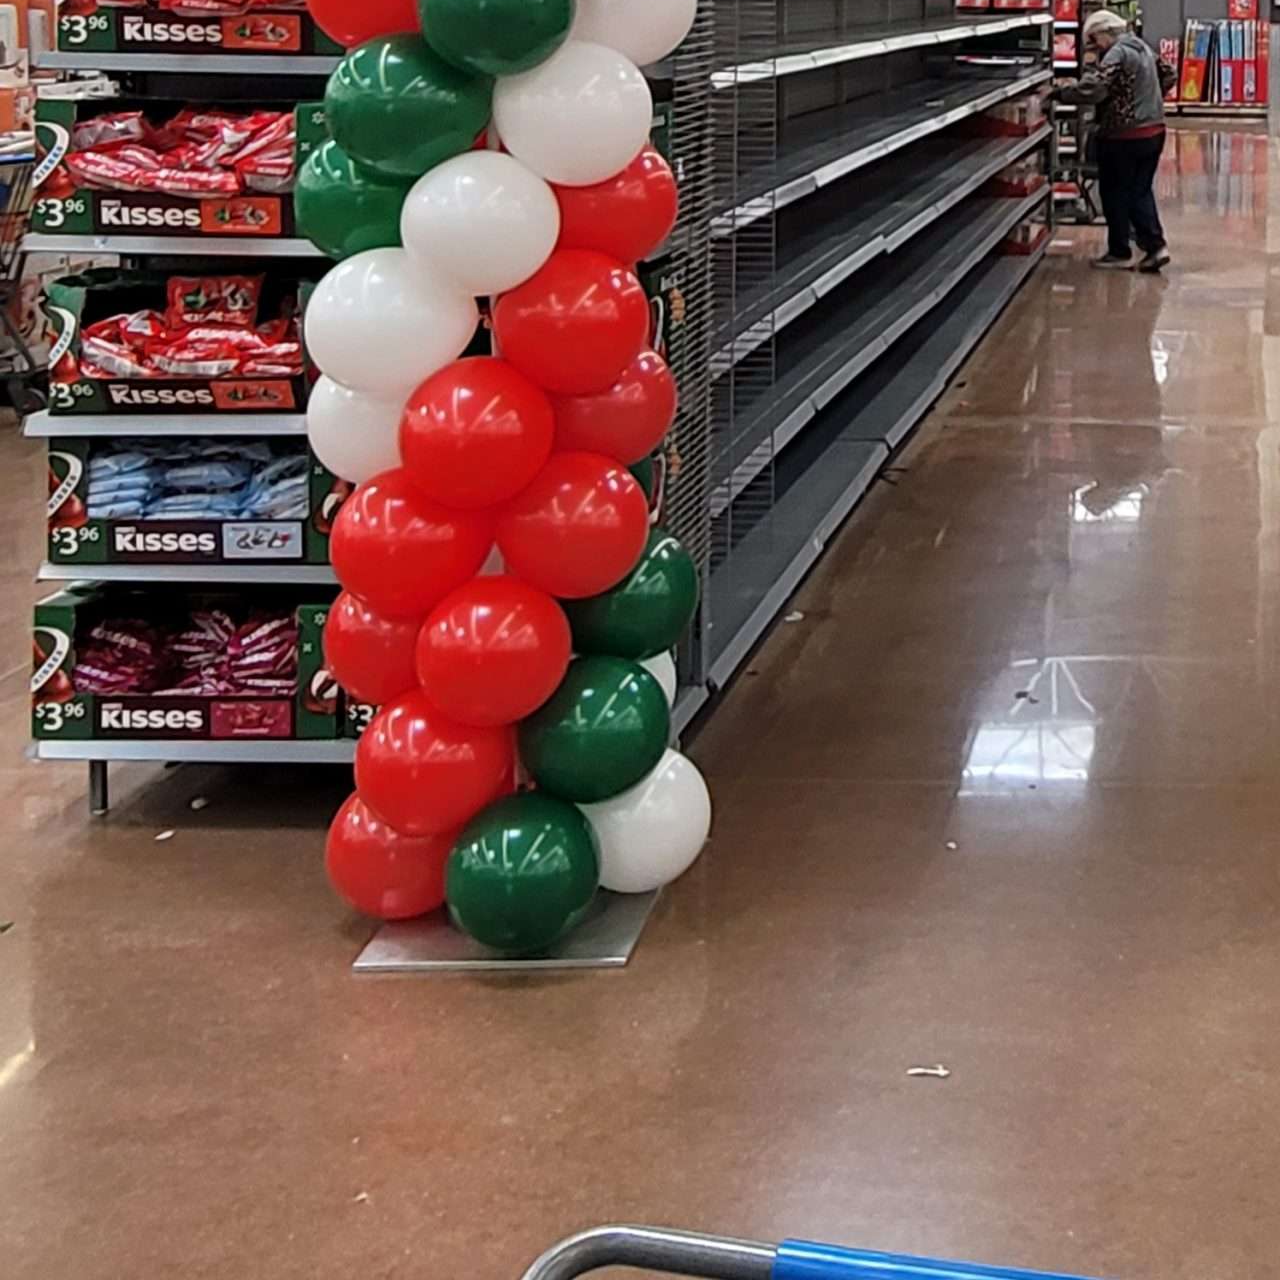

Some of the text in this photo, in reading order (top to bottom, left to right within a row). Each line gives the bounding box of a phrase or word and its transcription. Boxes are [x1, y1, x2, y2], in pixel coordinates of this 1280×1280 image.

[61, 16, 108, 43] $396
[37, 198, 85, 227] $396
[52, 526, 99, 555] $396
[35, 703, 85, 731] $396
